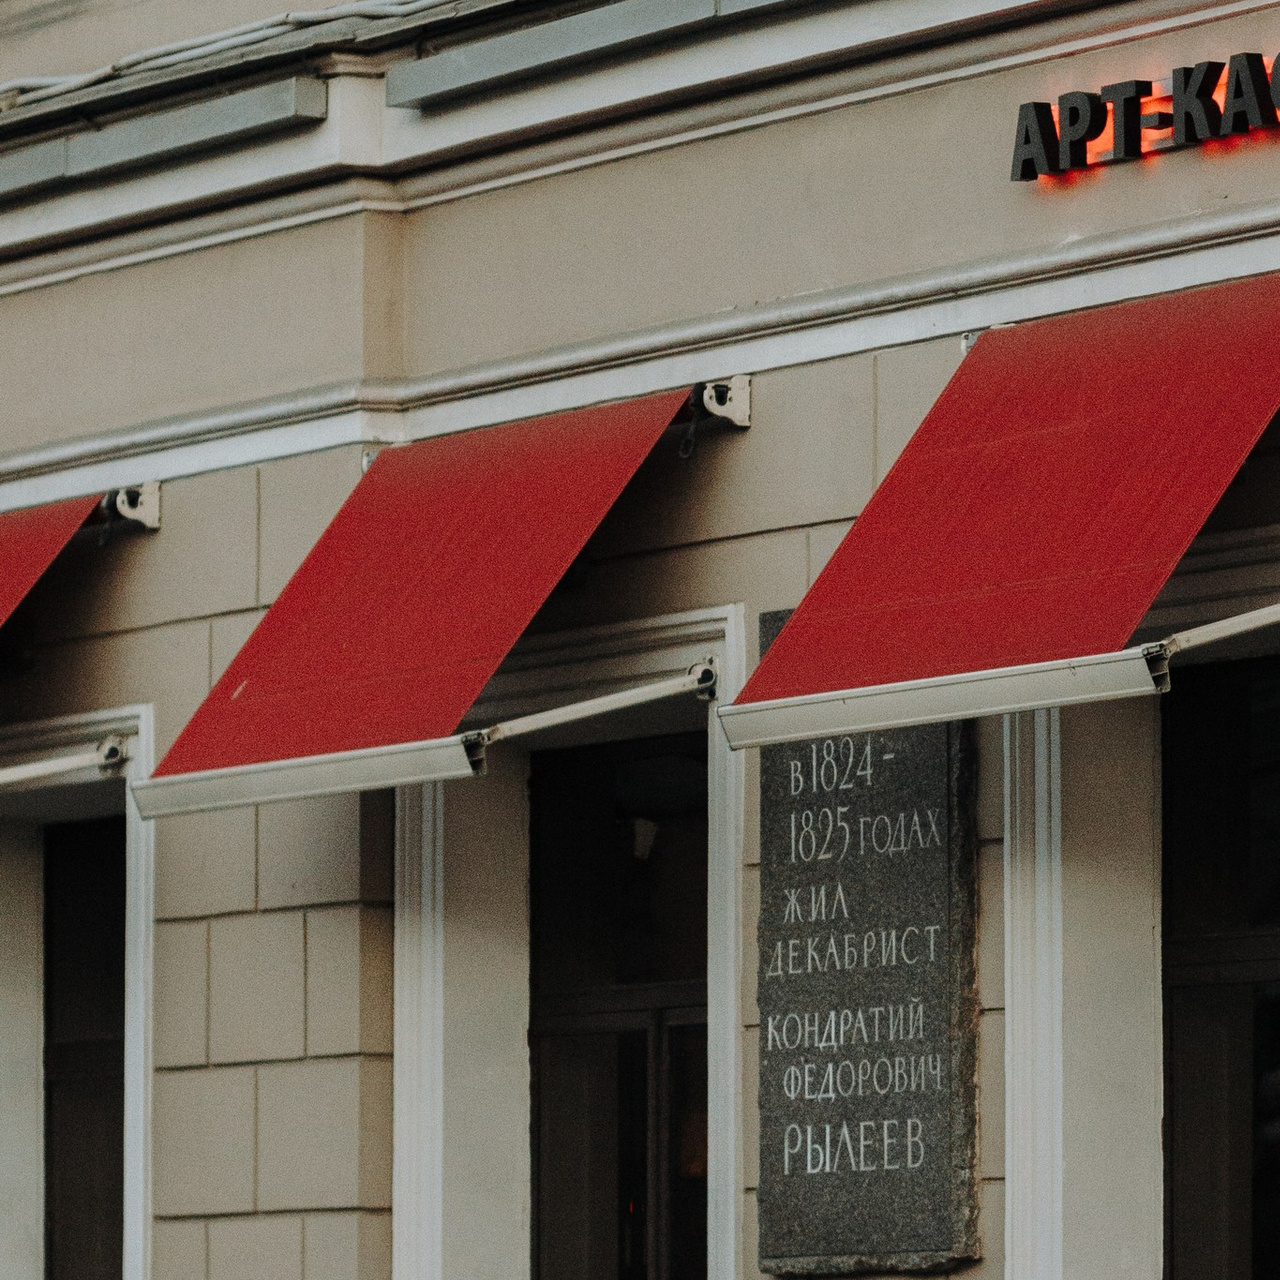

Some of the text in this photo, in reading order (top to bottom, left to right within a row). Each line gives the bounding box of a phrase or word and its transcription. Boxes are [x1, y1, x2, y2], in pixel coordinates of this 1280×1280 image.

[790, 806, 941, 862] 1825 ГОДАХ
[783, 882, 849, 923] ЖИЛ
[766, 925, 941, 978] ДЕКАБРИСТ
[766, 997, 924, 1052] КОНДРАТИЙ
[783, 1053, 943, 1102] ФЕДОРОВИЧ
[783, 1119, 925, 1176] РЫЛЕЕВ
